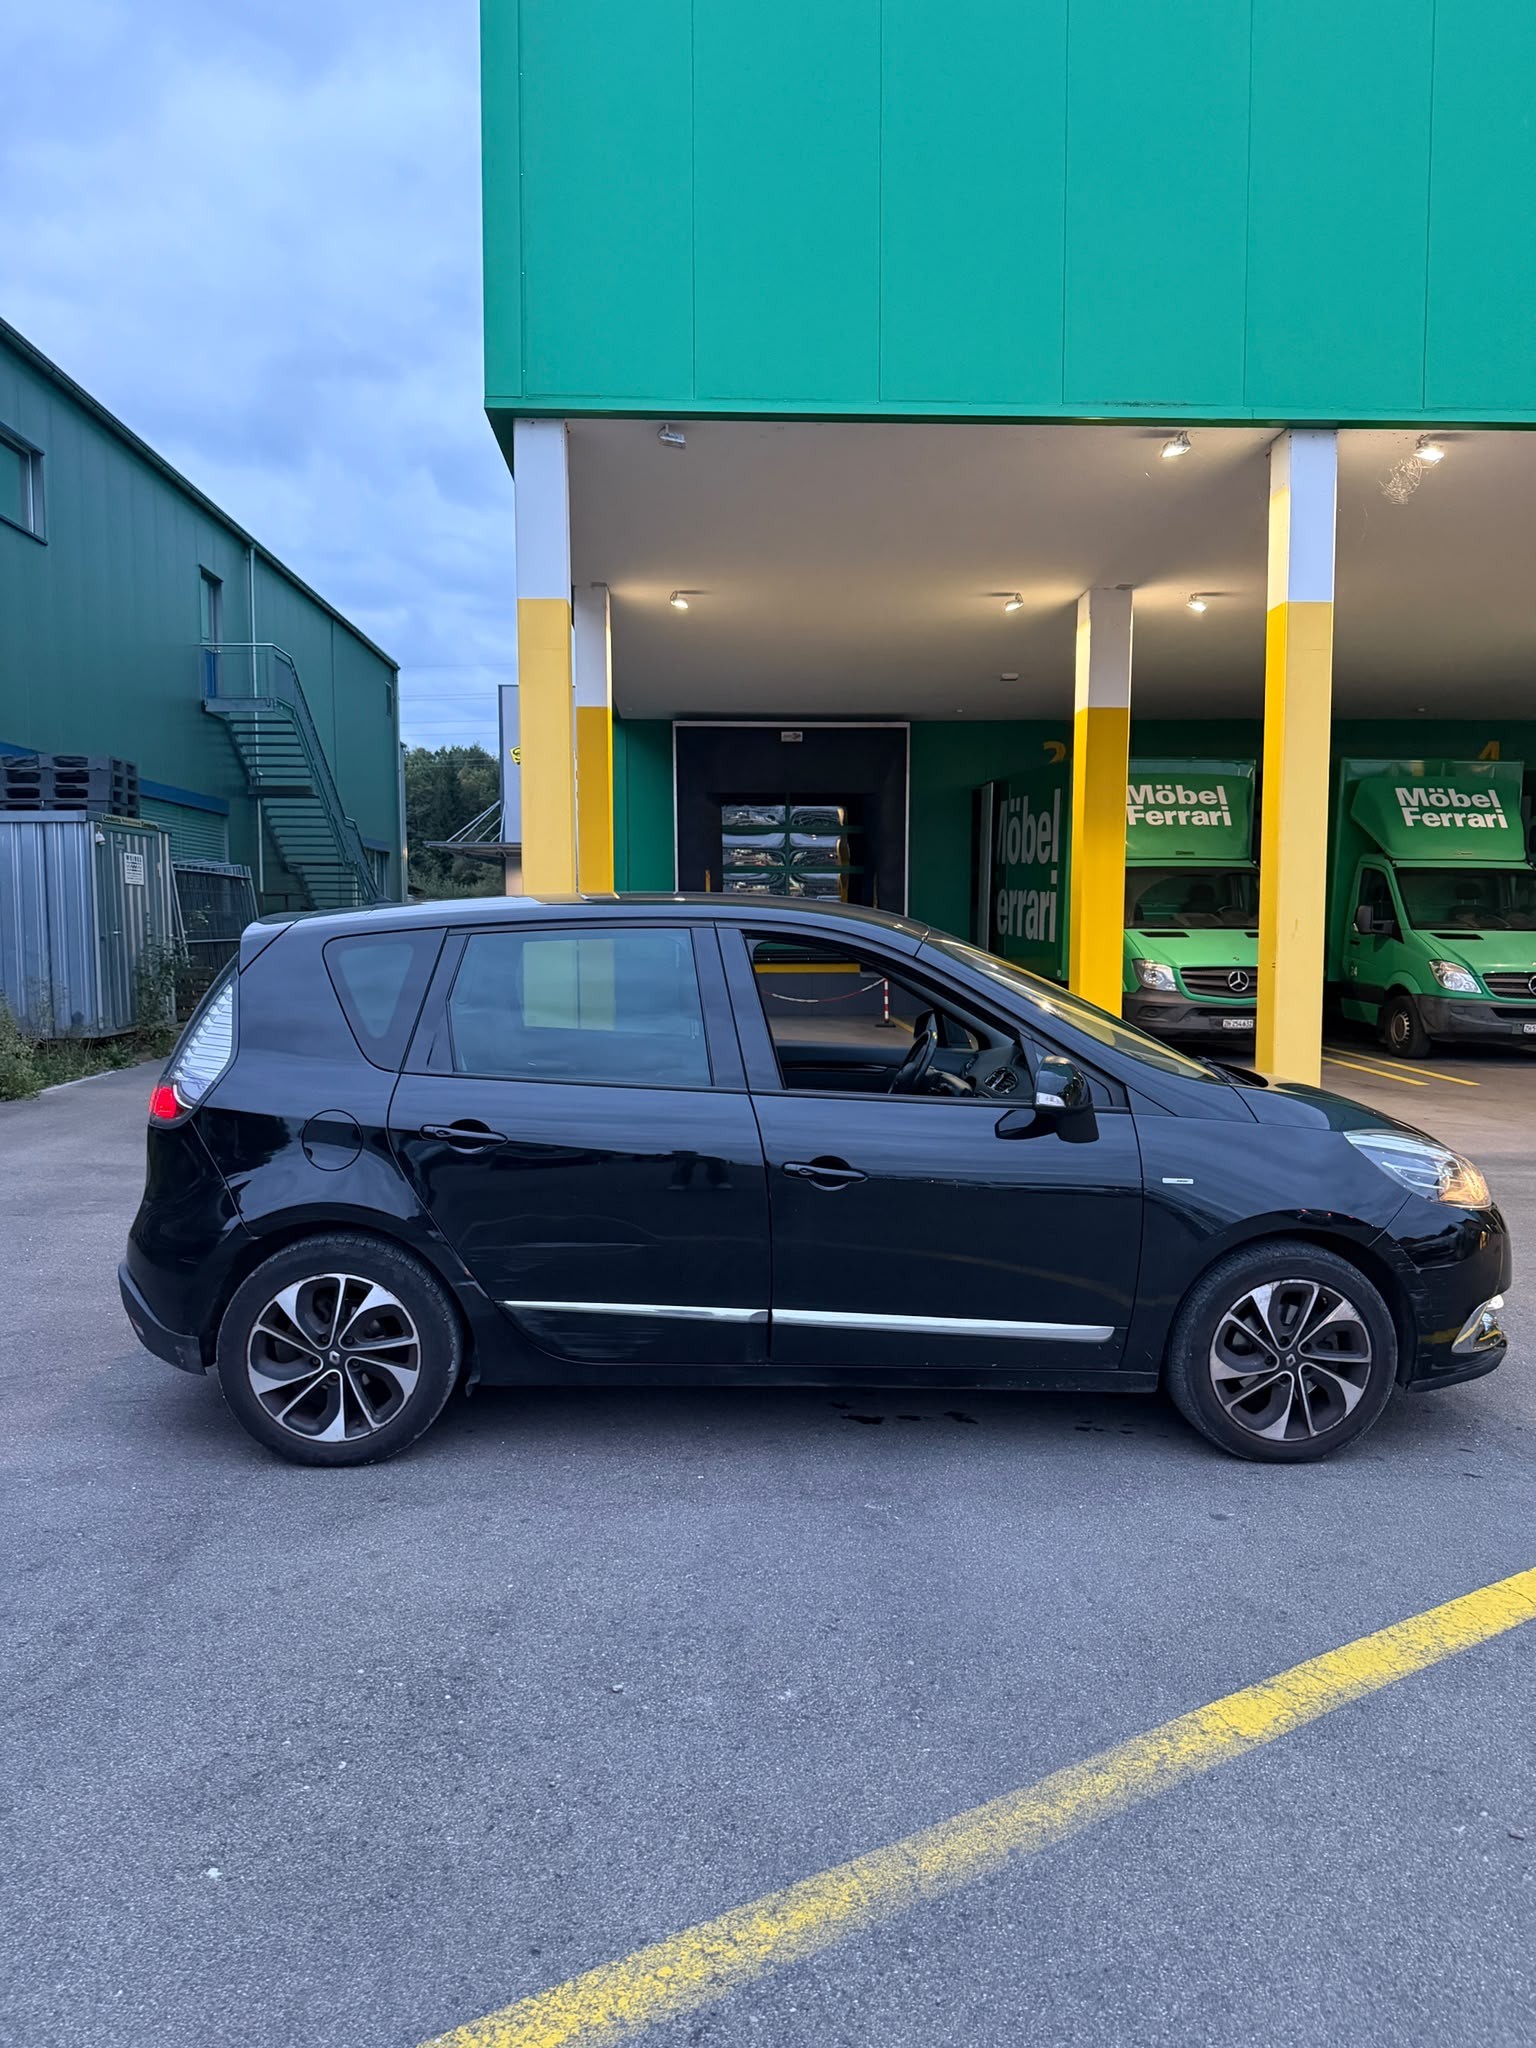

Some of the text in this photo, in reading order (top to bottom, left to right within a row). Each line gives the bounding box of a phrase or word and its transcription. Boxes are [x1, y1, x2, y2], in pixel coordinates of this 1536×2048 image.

[1127, 784, 1228, 805] Möbel
[1395, 787, 1502, 808] Möbel
[1126, 805, 1232, 826] Ferrari
[1401, 807, 1508, 828] Ferrari
[997, 869, 1057, 943] errari
